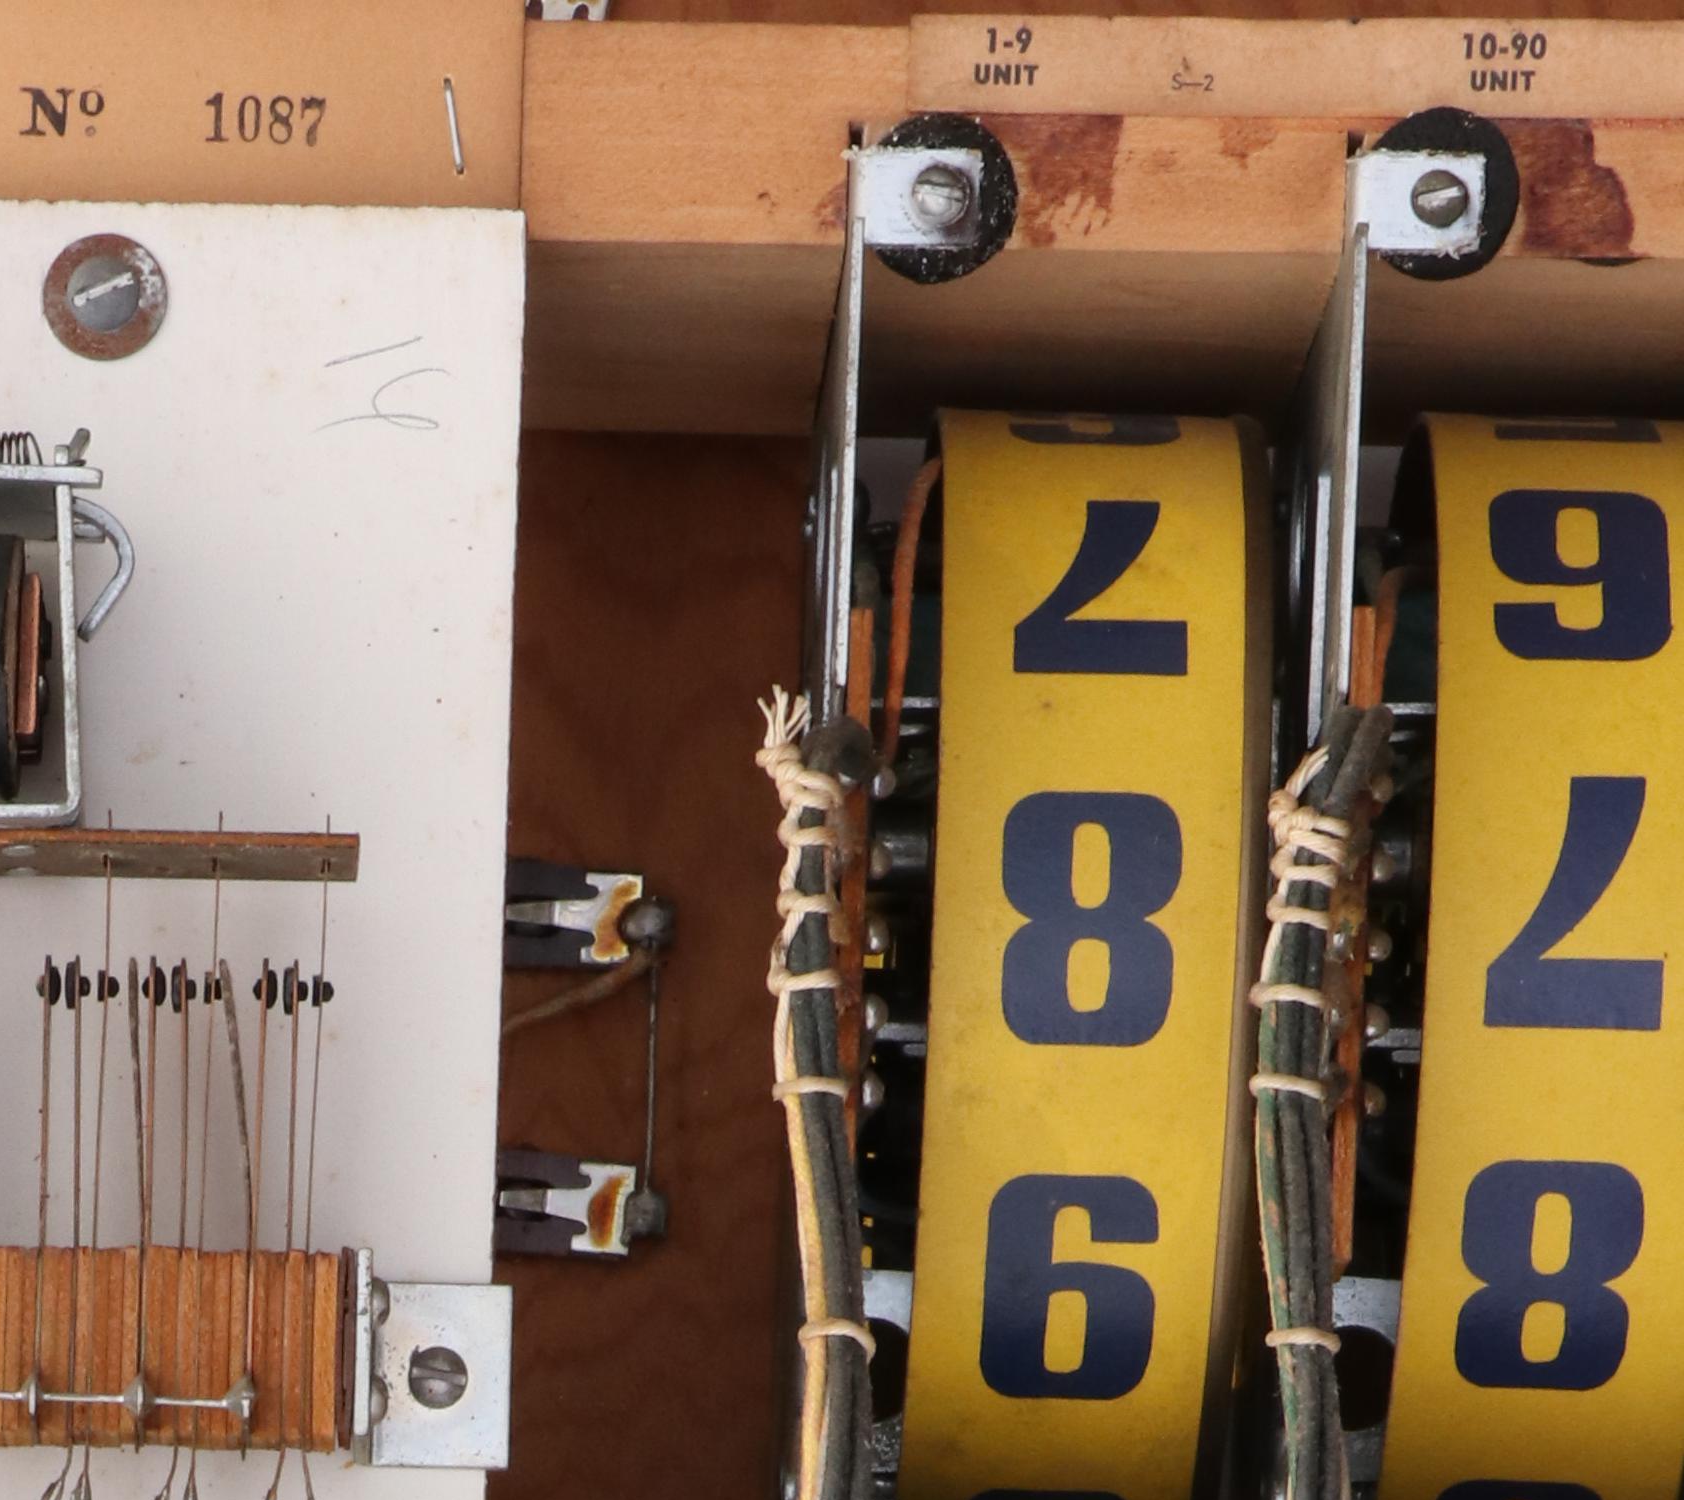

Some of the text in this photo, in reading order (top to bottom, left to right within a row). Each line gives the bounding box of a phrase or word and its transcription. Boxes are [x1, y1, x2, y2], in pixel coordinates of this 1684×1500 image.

[986, 26, 1034, 55] 1-9
[1463, 31, 1547, 61] 10-90
[973, 63, 1040, 86] UNIT
[1470, 69, 1536, 92] UNIT
[205, 92, 327, 148] 1087
[1013, 500, 1188, 677] 7
[1001, 791, 1183, 1047] 8
[1483, 776, 1663, 1030] 7
[1454, 1160, 1645, 1390] 8
